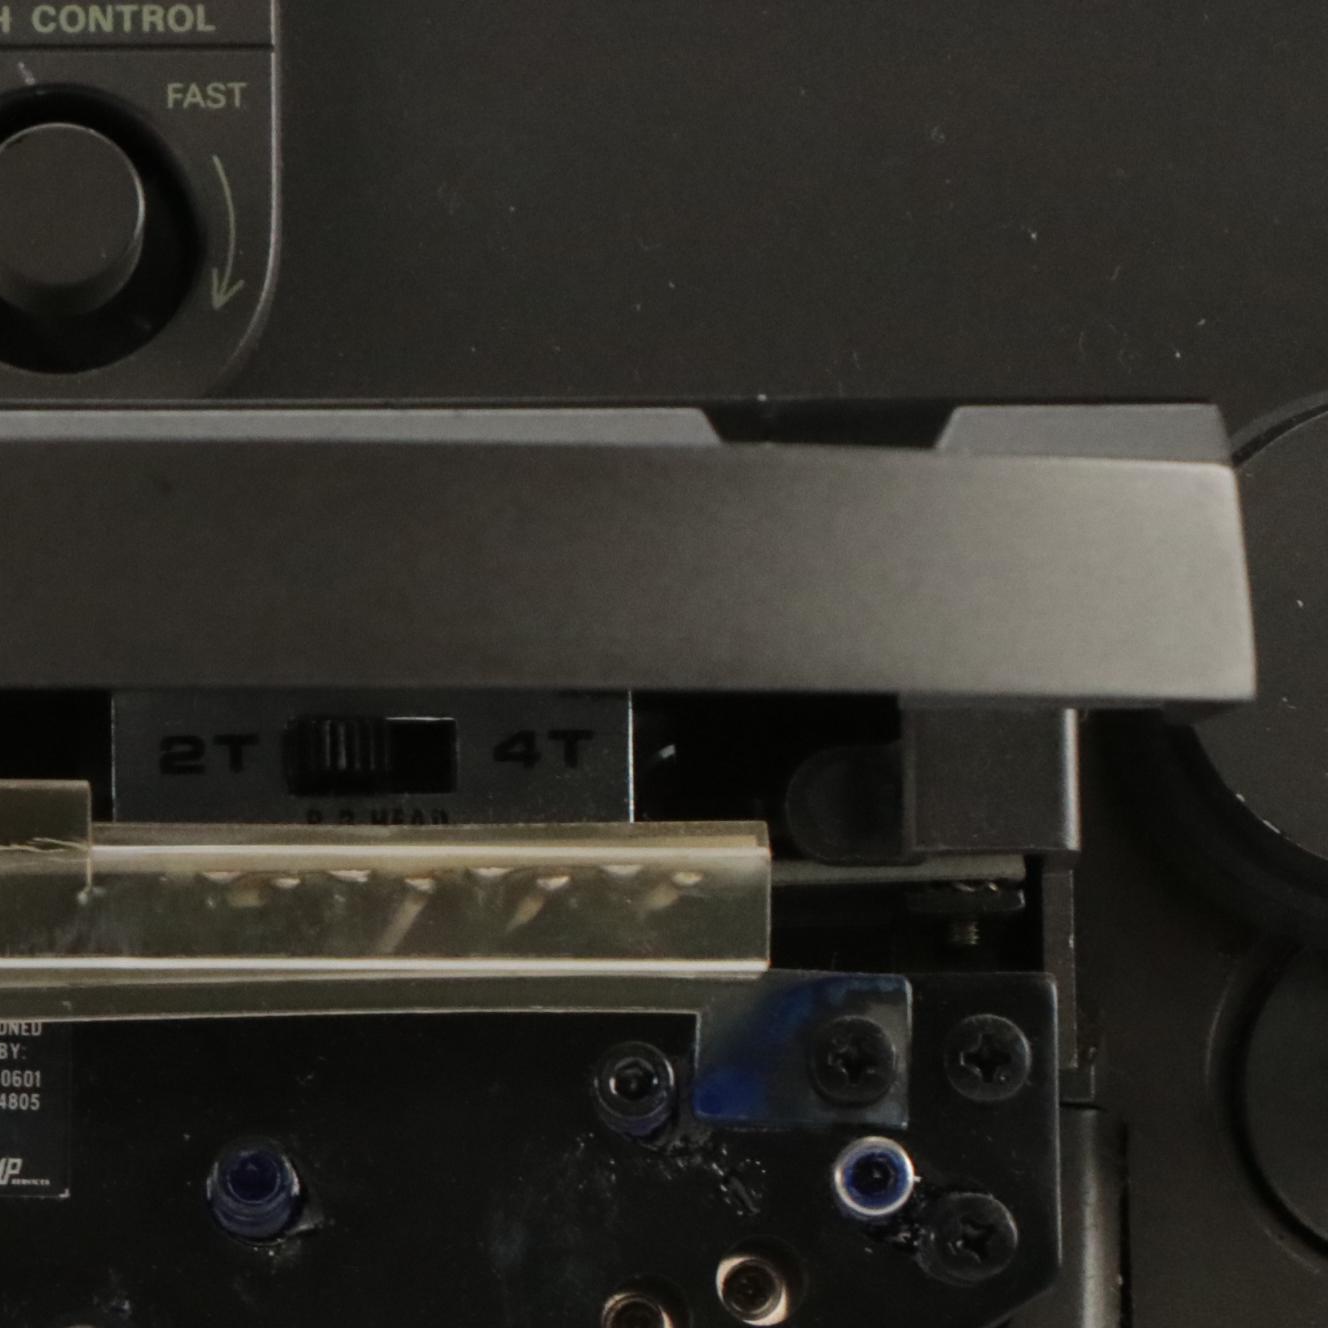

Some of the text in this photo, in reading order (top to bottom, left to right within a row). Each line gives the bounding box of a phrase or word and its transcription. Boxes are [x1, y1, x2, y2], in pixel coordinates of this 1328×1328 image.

[31, 3, 216, 34] CONTROL
[167, 81, 247, 110] FAST
[159, 733, 260, 776] 2T
[492, 728, 595, 769] 4T
